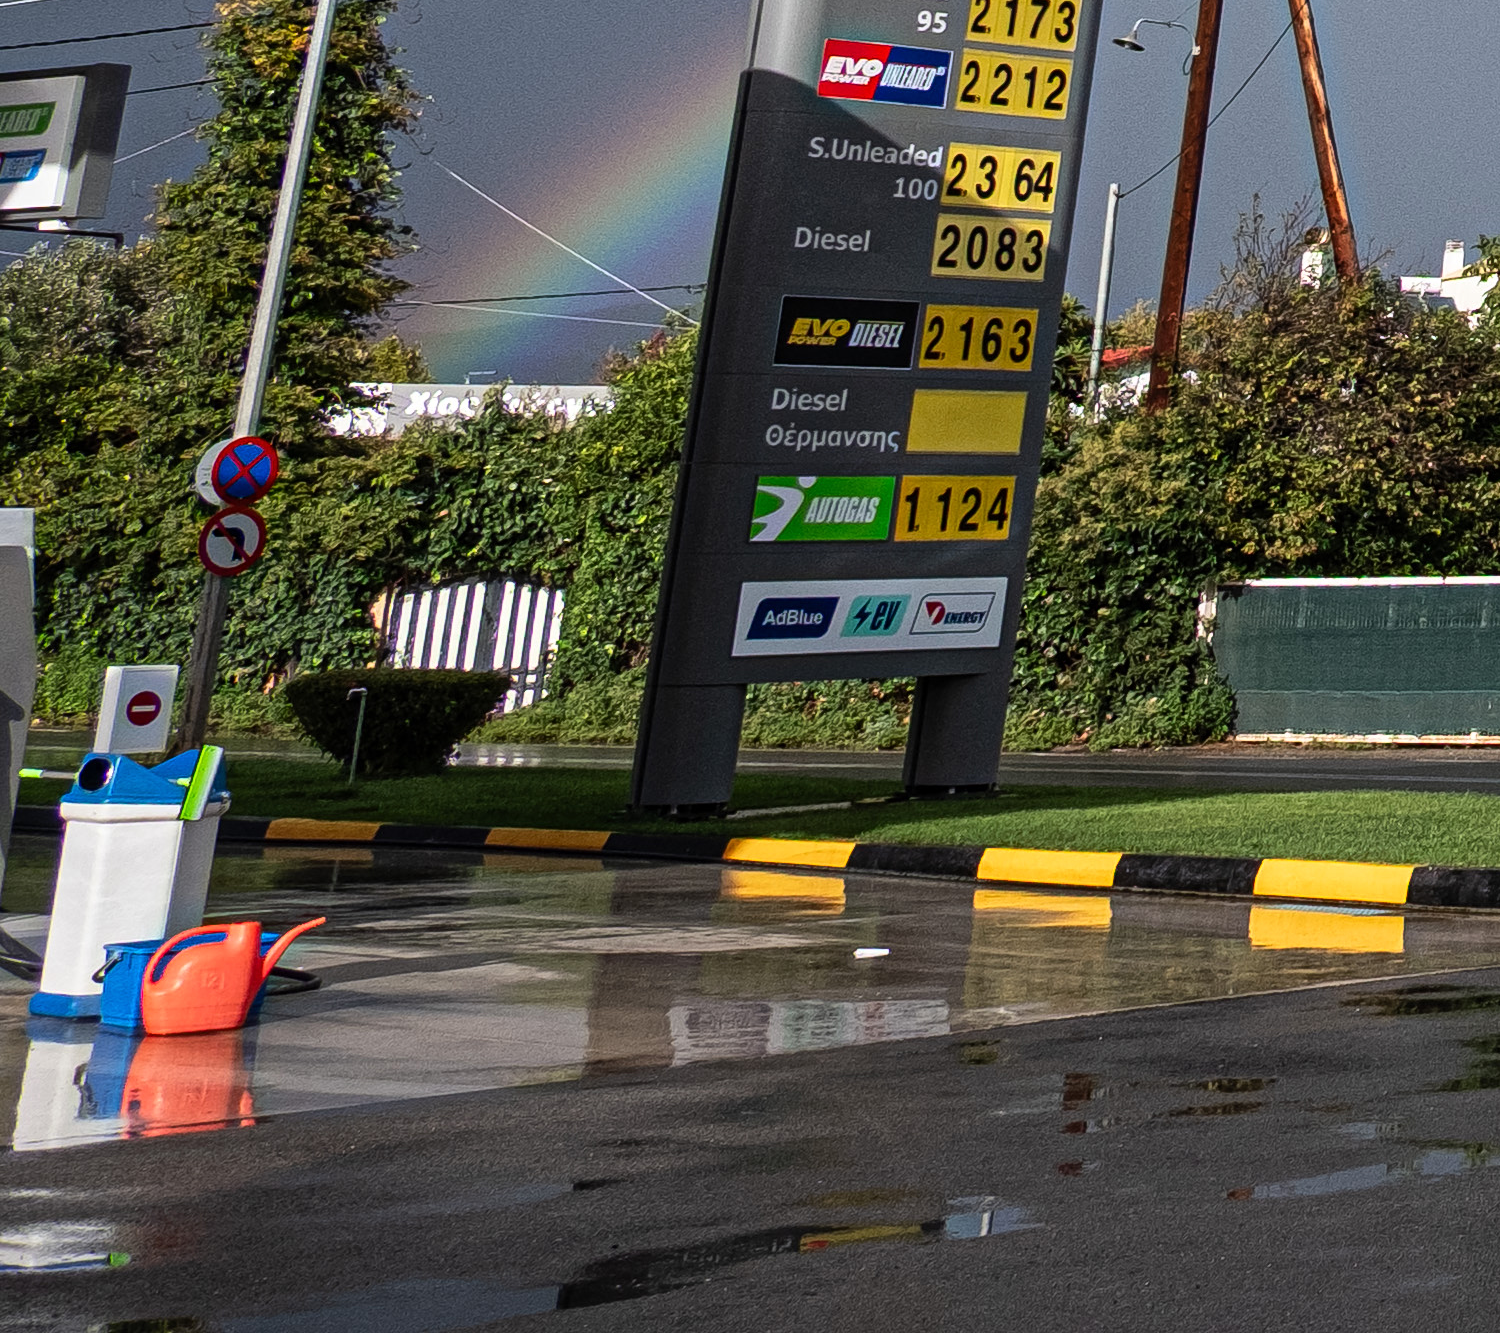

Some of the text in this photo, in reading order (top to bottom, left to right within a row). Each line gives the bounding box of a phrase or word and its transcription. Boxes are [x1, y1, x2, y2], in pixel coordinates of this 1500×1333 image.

[916, 10, 949, 34] 95
[820, 73, 871, 85] POWER
[824, 55, 884, 78] EVO
[879, 63, 938, 91] UNLEADED
[808, 136, 944, 168] S.Unleaded
[893, 177, 938, 201] 100
[793, 226, 871, 252] Diesel
[789, 317, 851, 338] EVO
[848, 322, 906, 348] DIESEL
[787, 335, 837, 346] POWER
[771, 388, 849, 411] Diesel
[765, 421, 900, 452] Θέρμανσης
[804, 496, 880, 524] AUTOGAS
[761, 609, 823, 626] AdBlue
[870, 601, 902, 631] ev
